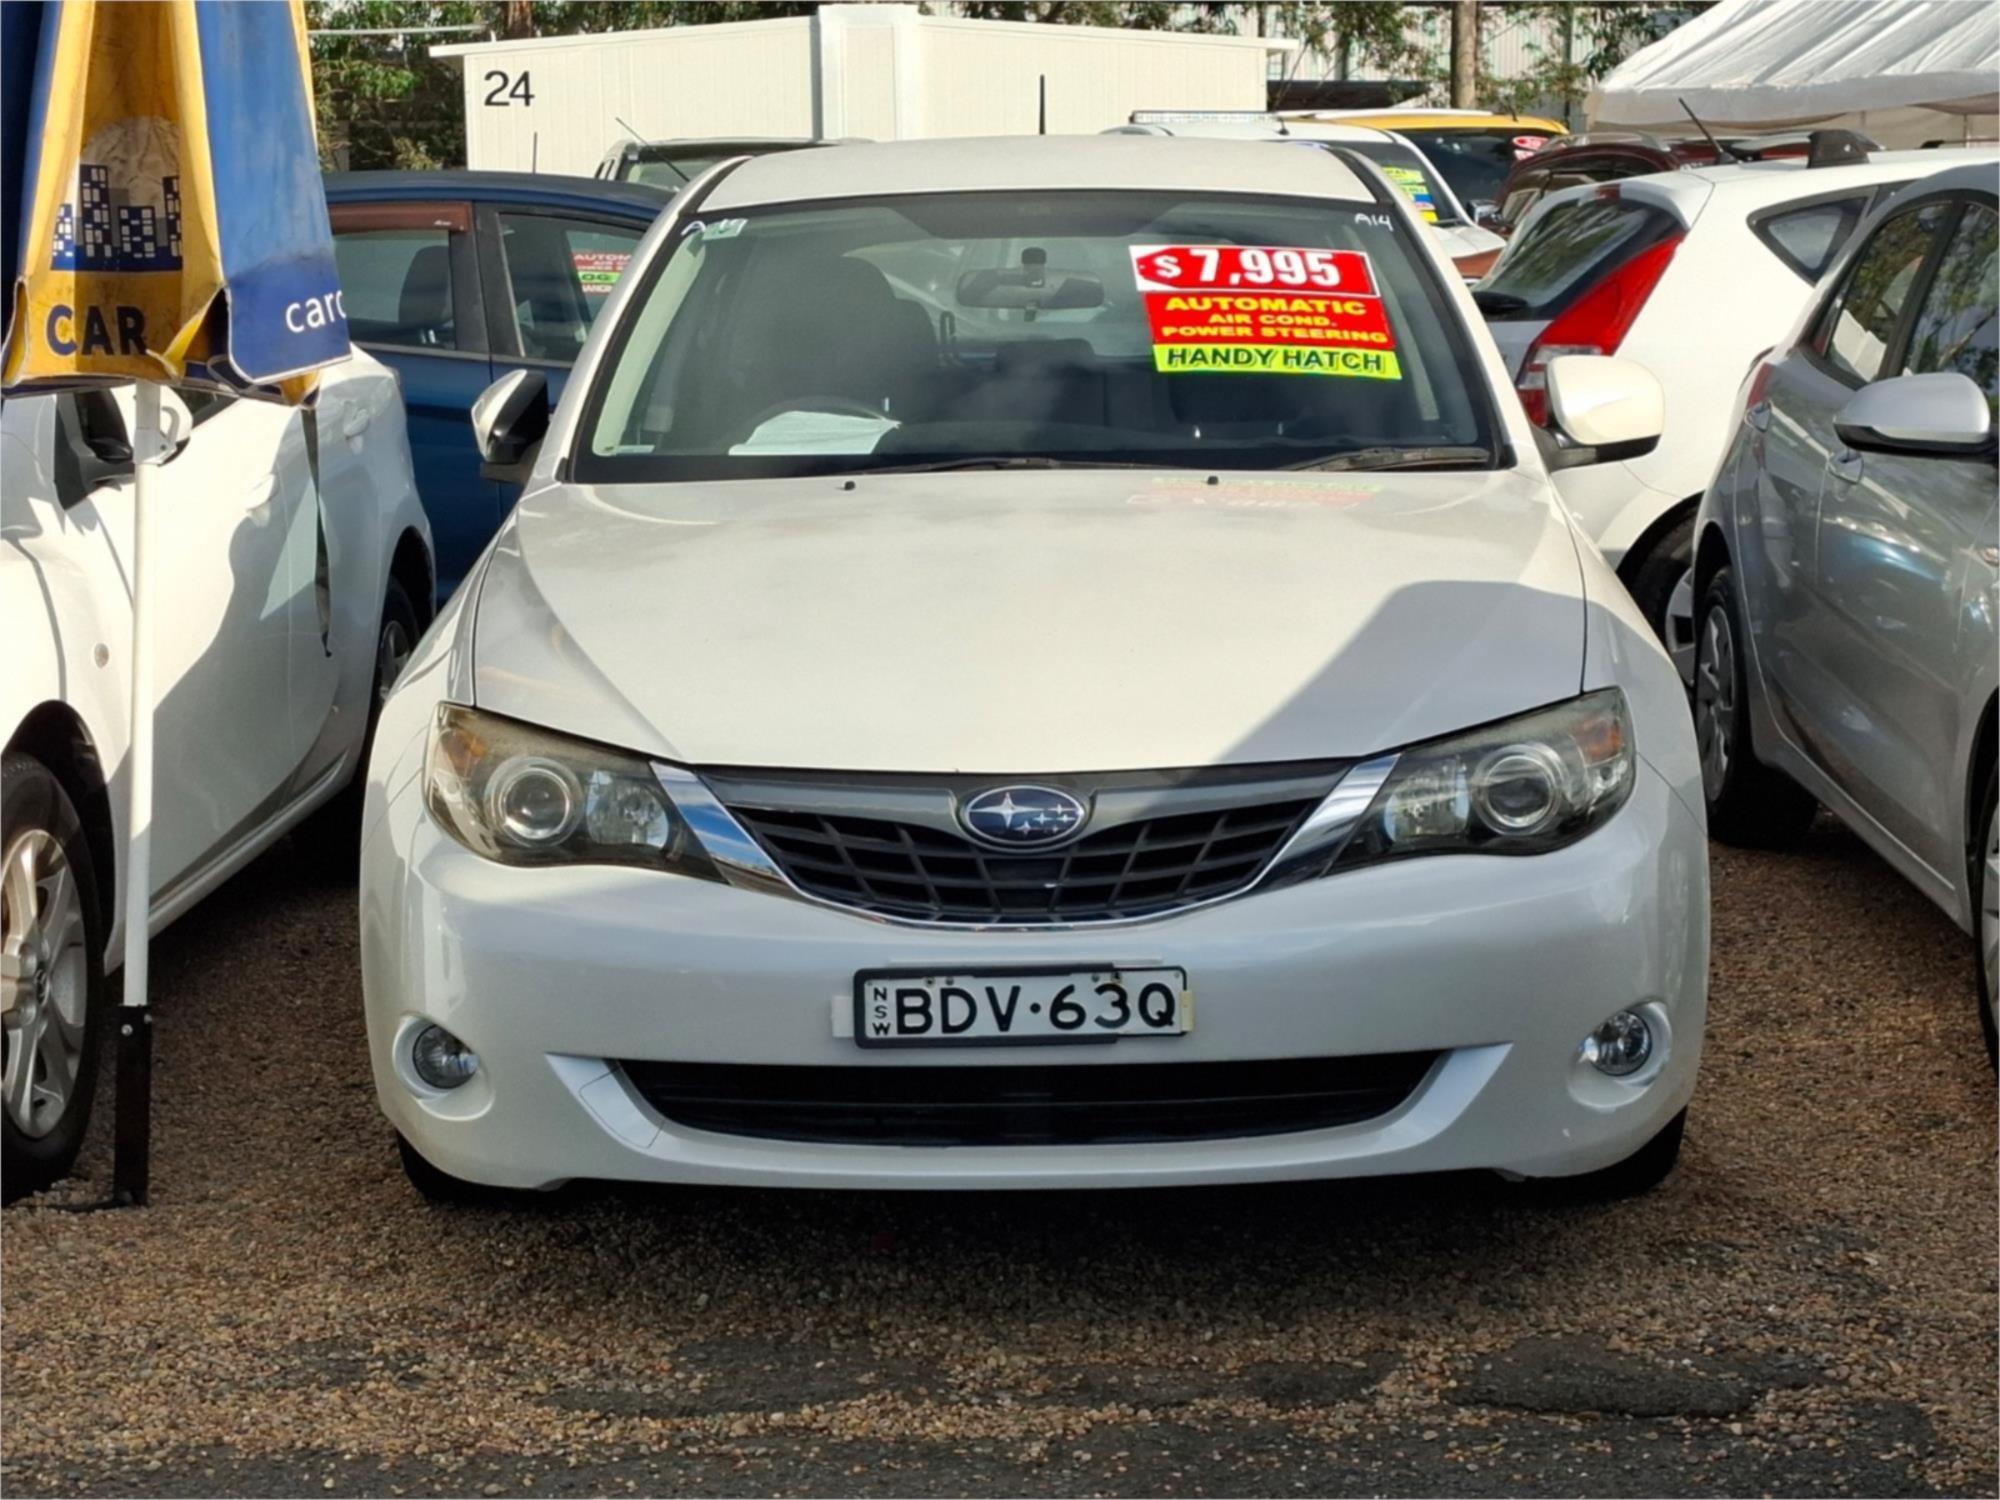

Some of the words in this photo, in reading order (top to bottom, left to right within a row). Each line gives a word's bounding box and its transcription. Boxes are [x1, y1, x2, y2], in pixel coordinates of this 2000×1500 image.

[484, 70, 535, 107] 24
[1165, 296, 1368, 315] AUTOMATIC
[46, 304, 147, 356] CAR
[1208, 313, 1254, 325] AIR
[1258, 314, 1338, 328] COND.
[1161, 325, 1254, 338] POWER
[1260, 326, 1388, 343] STEERING
[1166, 347, 1276, 369] HANDY
[1282, 350, 1384, 372] HATCH
